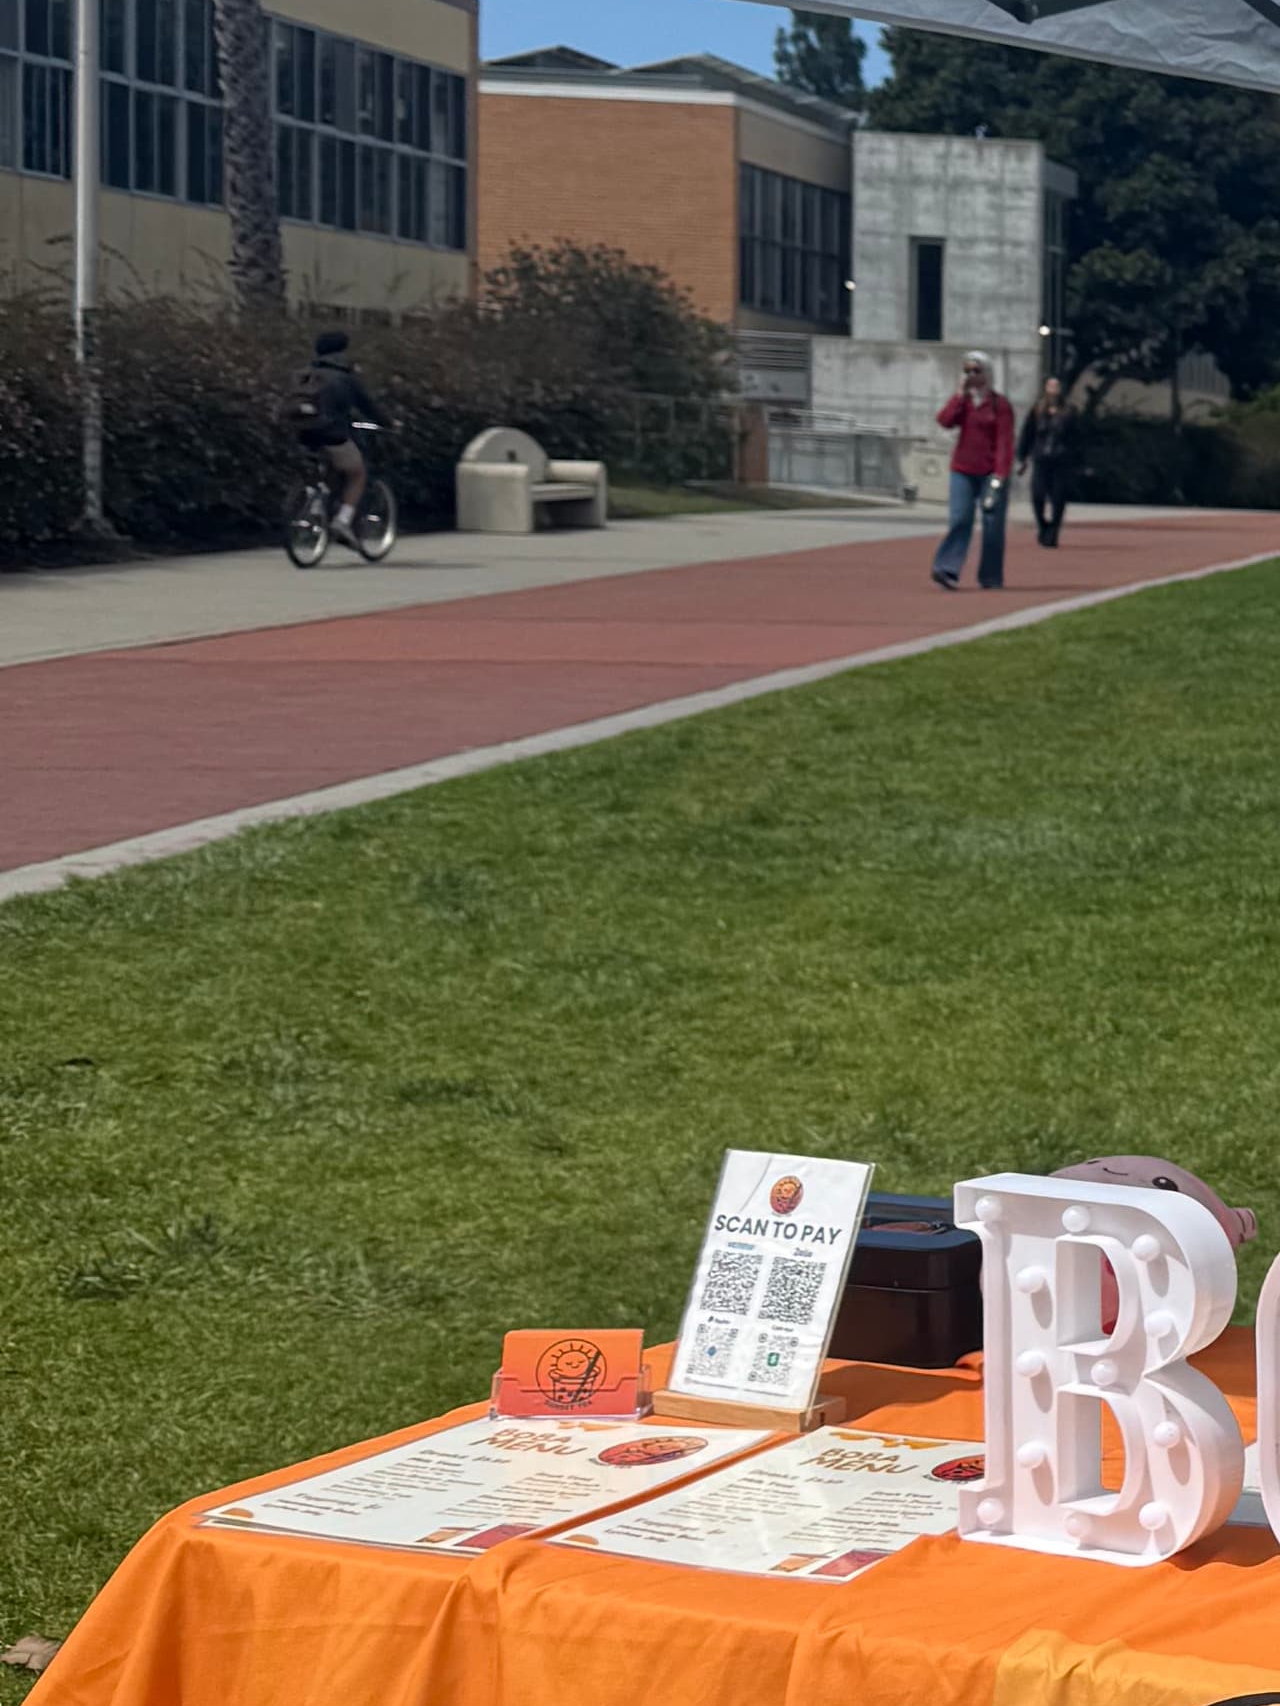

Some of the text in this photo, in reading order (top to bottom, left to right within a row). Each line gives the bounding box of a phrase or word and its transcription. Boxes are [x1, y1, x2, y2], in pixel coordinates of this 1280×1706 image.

[714, 1214, 843, 1246] SCAN TO PAY
[493, 1428, 572, 1443] BOBA
[468, 1436, 588, 1455] MENU
[821, 1448, 900, 1462] BOBA
[797, 1456, 919, 1474] MENU
